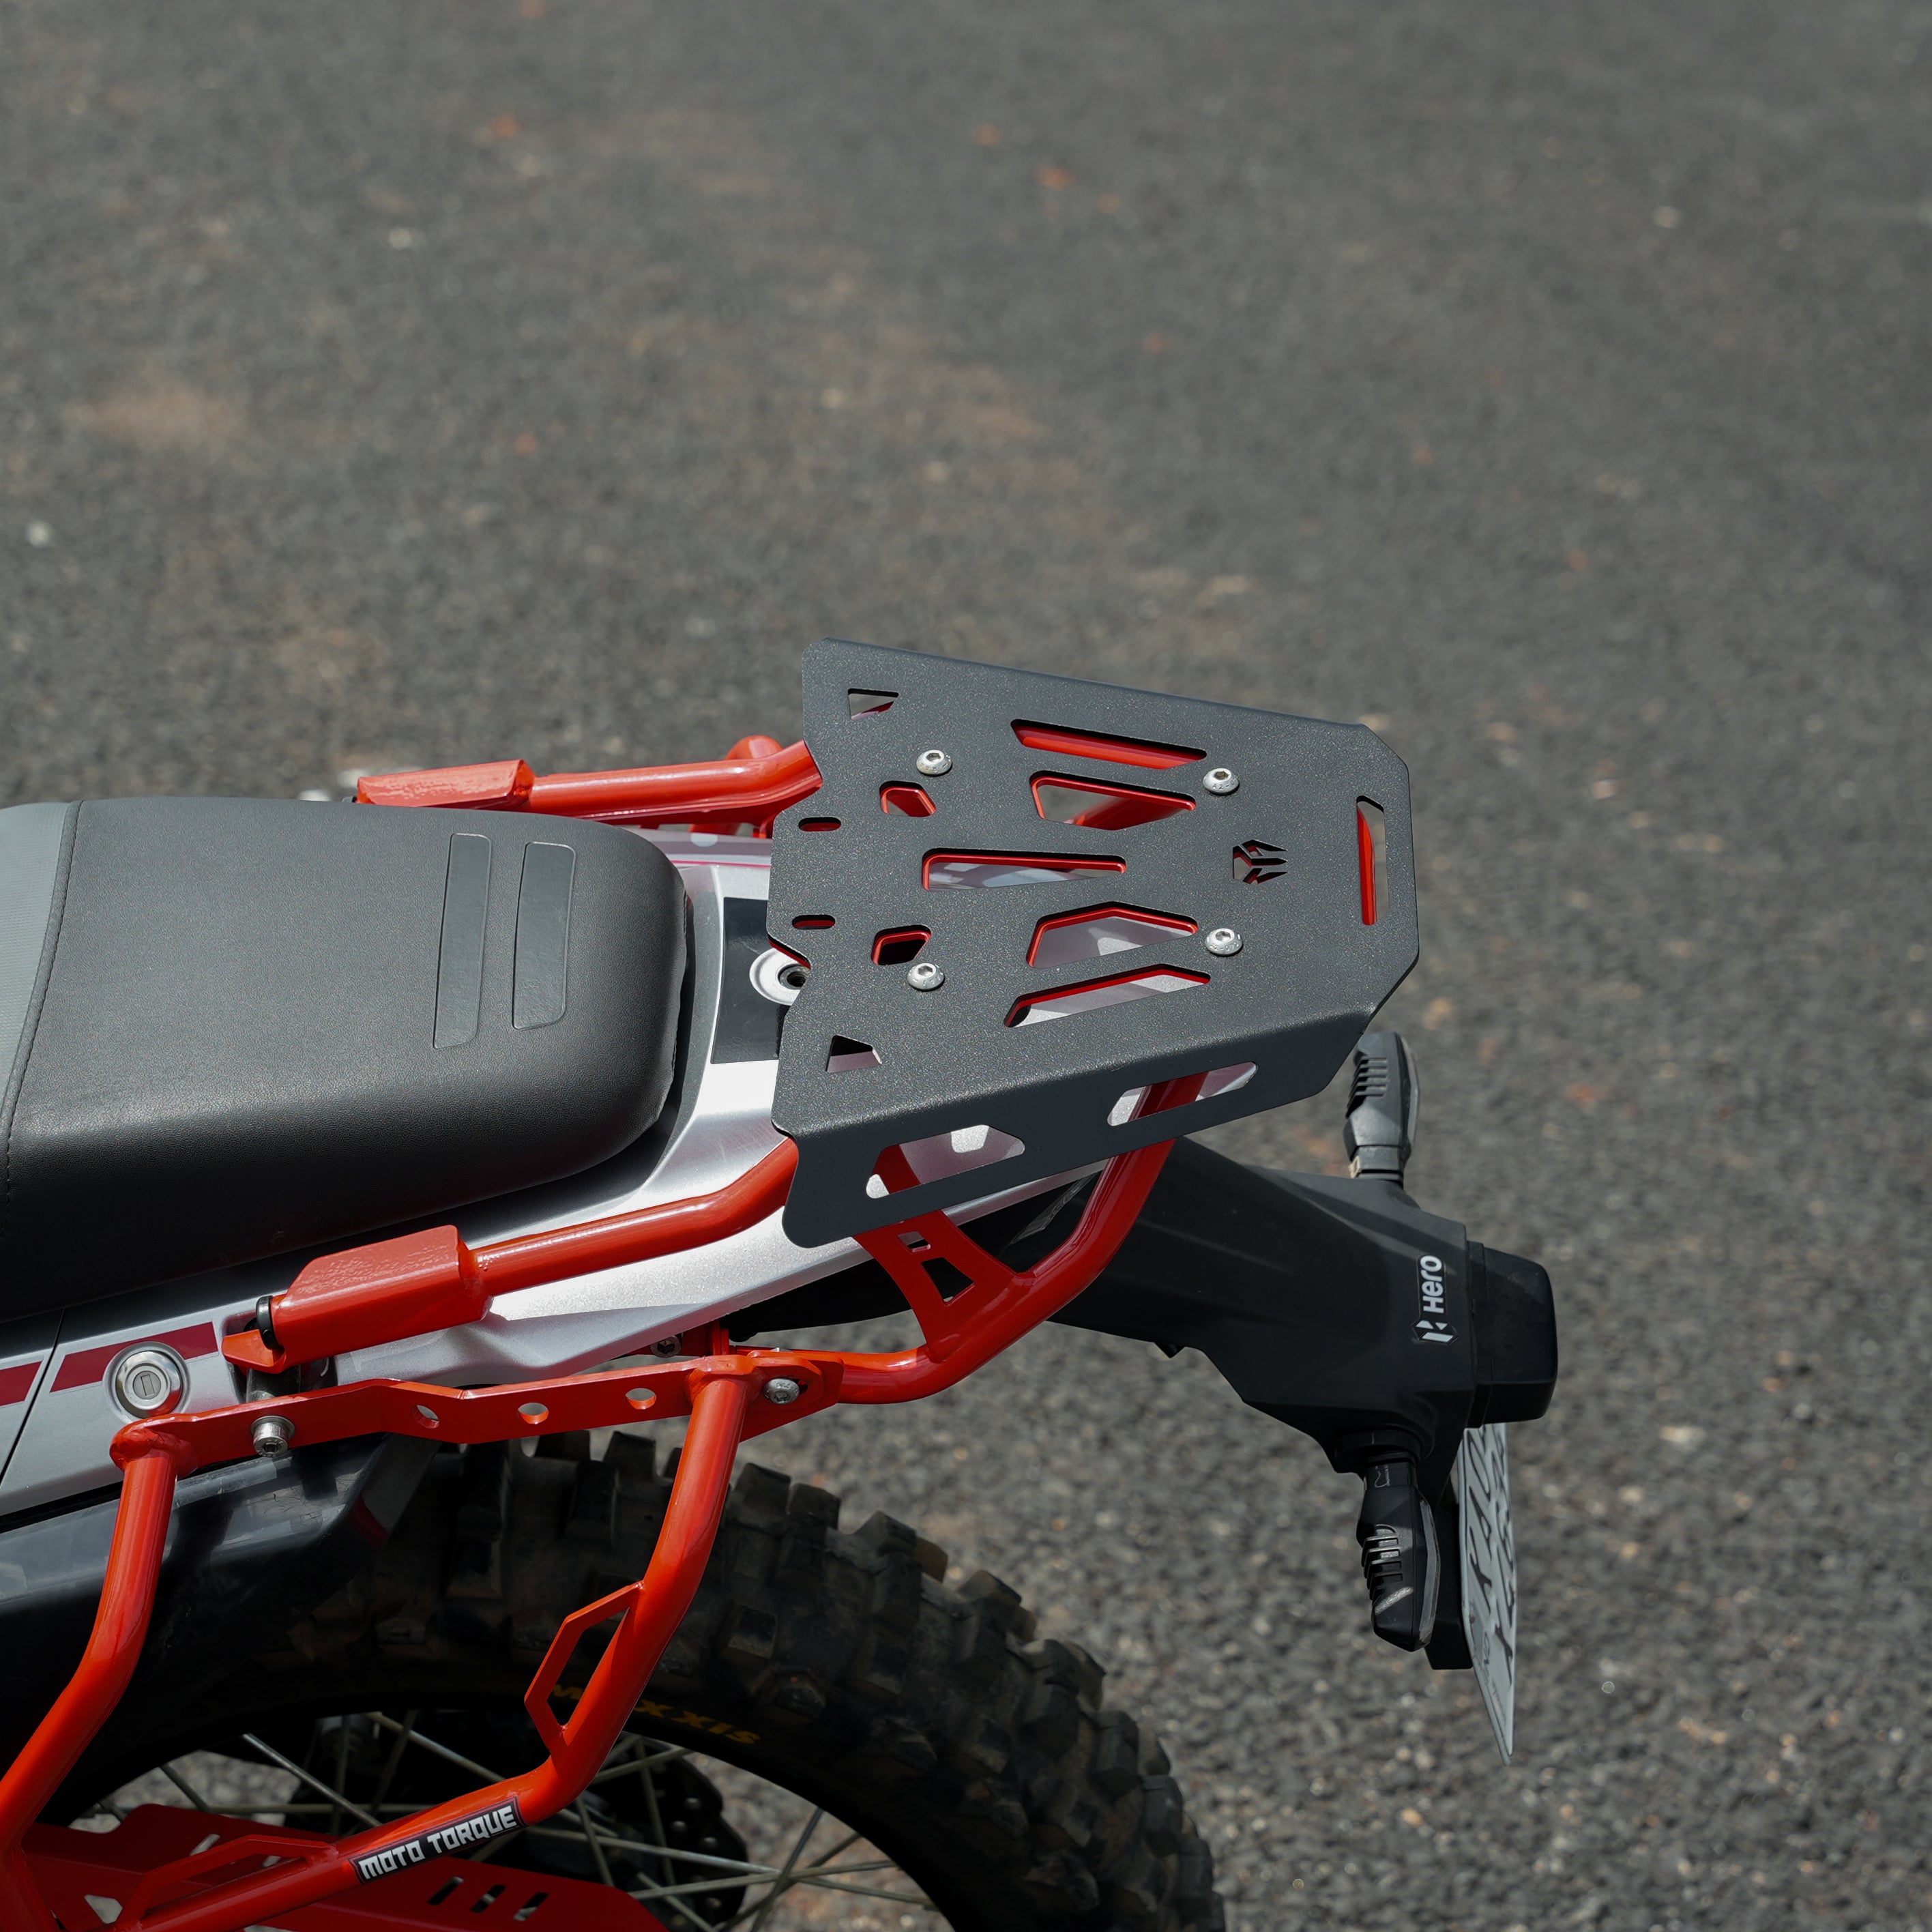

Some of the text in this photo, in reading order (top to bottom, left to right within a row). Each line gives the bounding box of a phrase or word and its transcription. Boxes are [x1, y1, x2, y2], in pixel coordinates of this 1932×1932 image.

[1420, 1255, 1444, 1314] Hero
[358, 1805, 517, 1879] MOTO TORQUE
